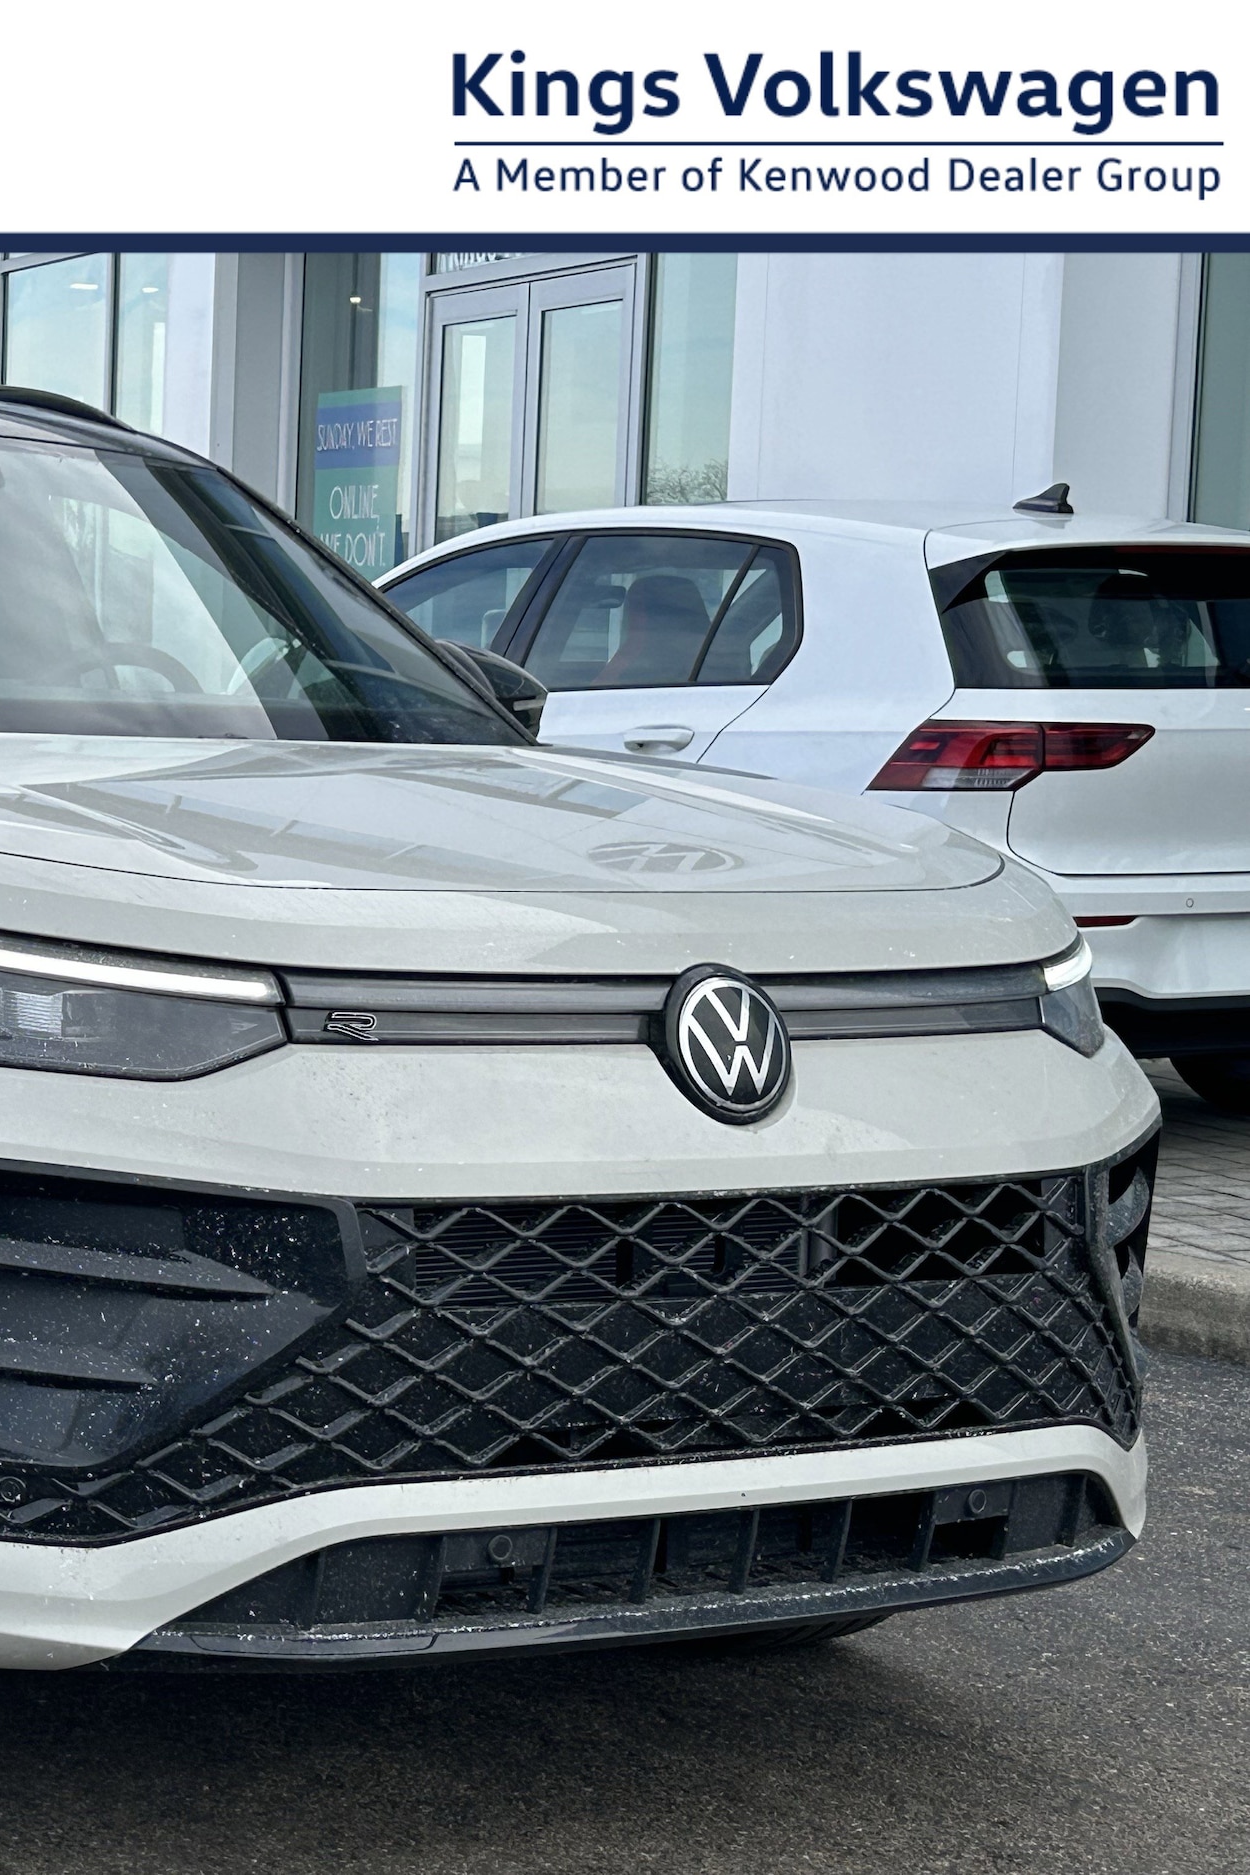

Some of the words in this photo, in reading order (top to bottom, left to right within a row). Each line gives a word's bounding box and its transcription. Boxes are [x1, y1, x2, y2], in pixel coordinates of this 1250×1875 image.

[357, 420, 374, 448] WE
[375, 418, 398, 447] REST
[683, 981, 782, 1104] VW
